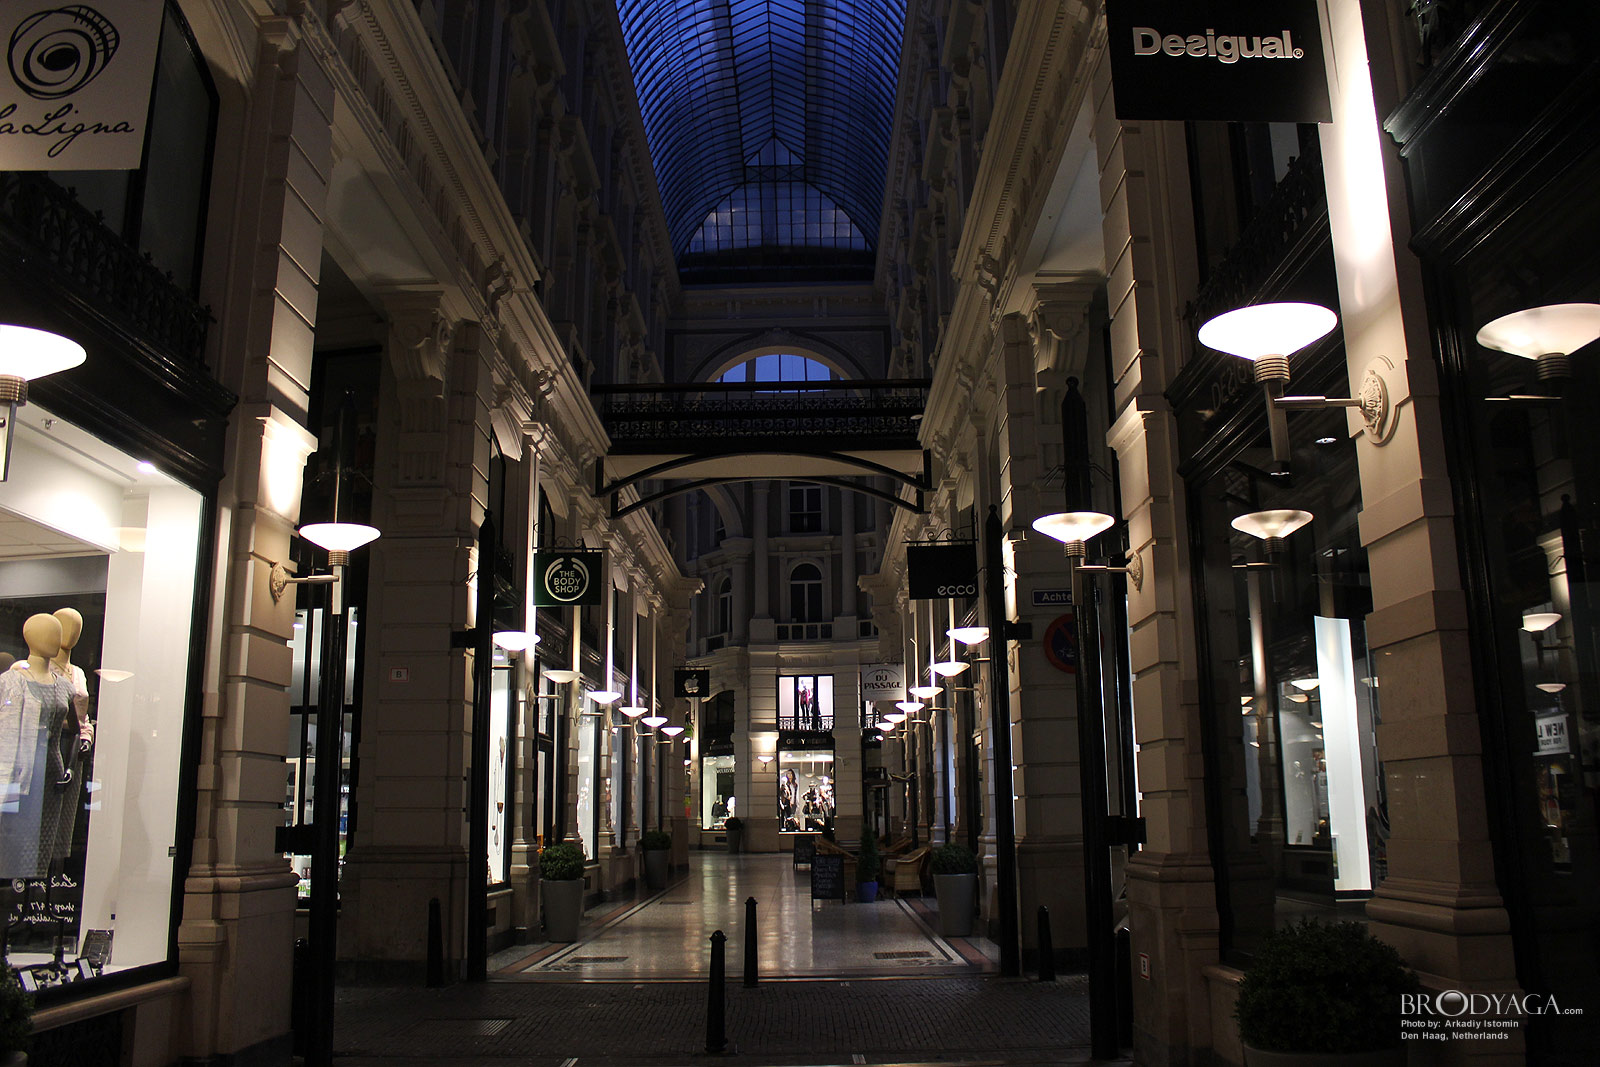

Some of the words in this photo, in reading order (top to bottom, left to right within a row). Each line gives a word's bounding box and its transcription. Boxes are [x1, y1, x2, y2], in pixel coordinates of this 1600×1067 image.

[559, 570, 575, 578] THE
[553, 577, 581, 586] BODY
[554, 585, 580, 593] SHOP
[937, 584, 976, 596] ecco
[1042, 592, 1073, 602] Achte
[875, 674, 888, 682] DU
[863, 681, 903, 690] PASSAGE
